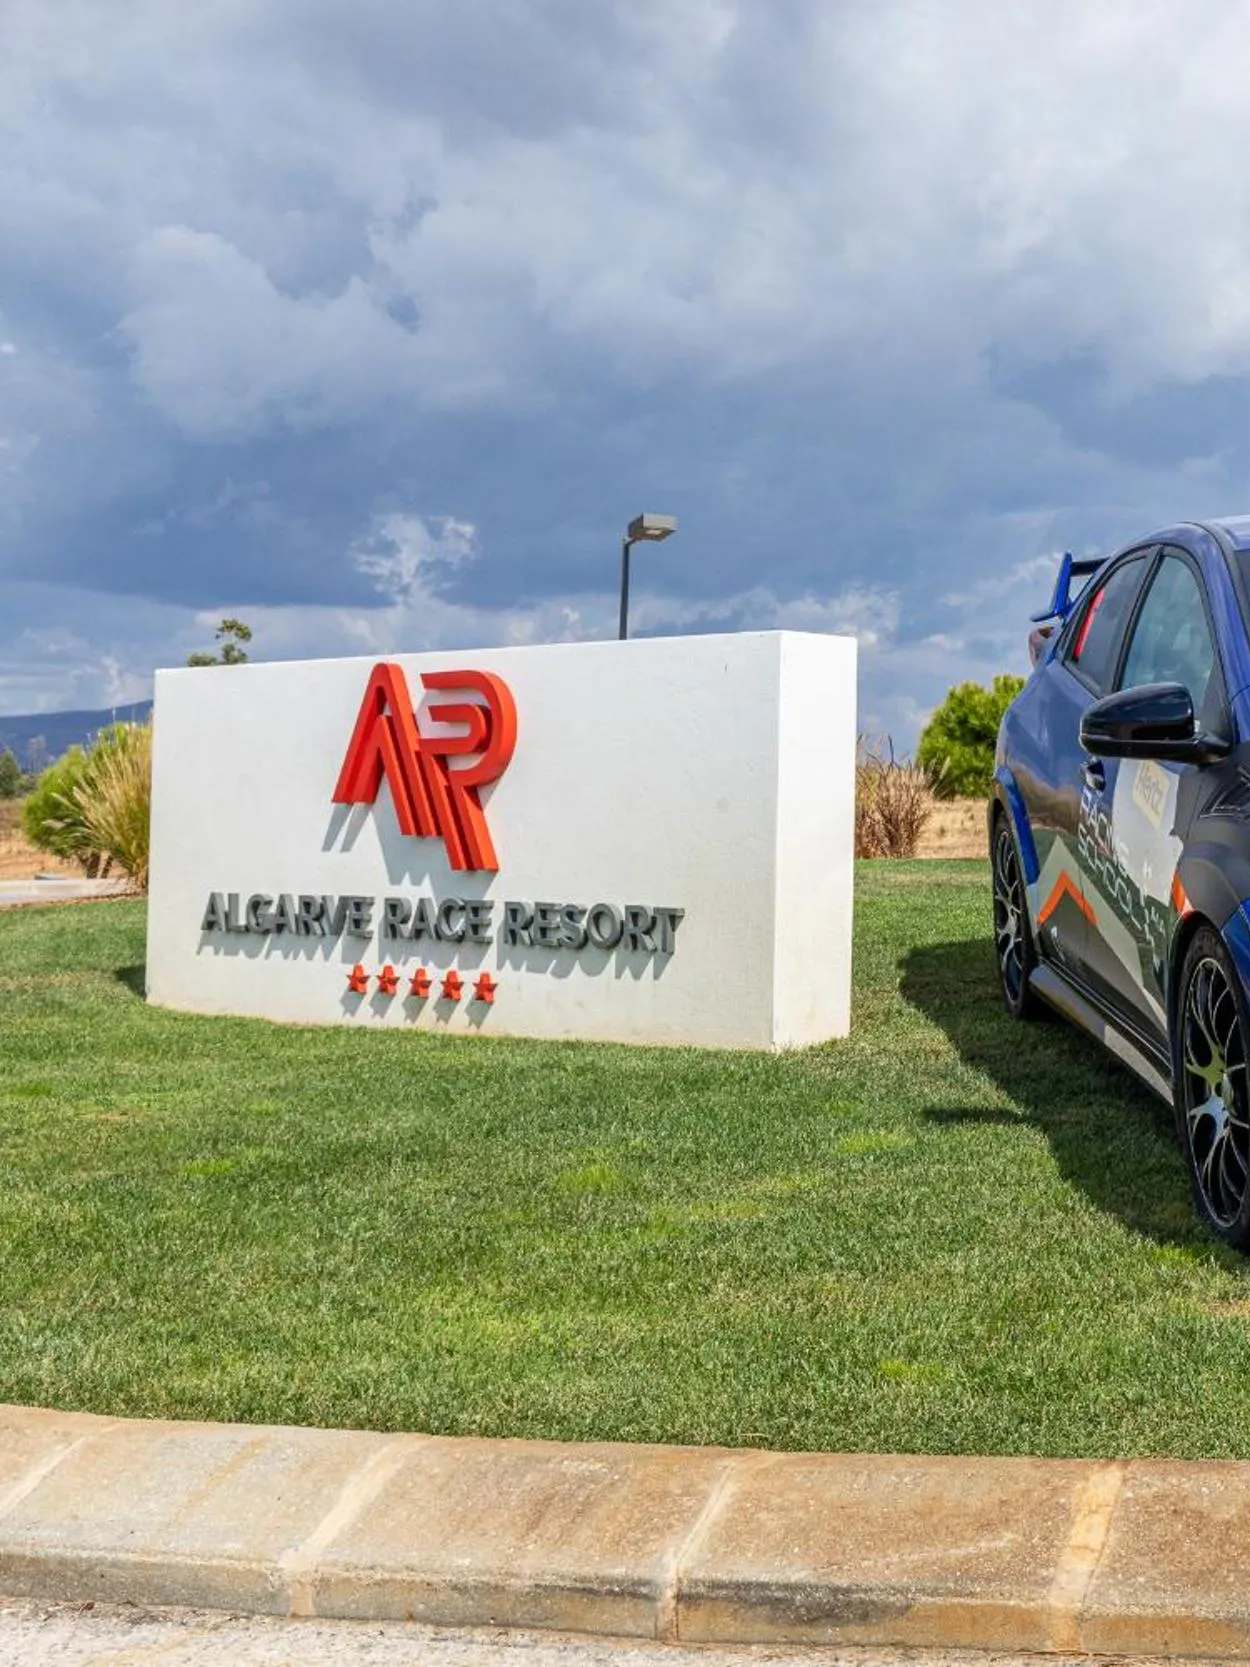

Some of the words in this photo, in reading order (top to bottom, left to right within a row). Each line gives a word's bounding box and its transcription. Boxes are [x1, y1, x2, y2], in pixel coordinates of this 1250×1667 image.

[200, 892, 375, 940] ALGARVE
[383, 897, 495, 944] RACE
[503, 900, 686, 955] RESORT
